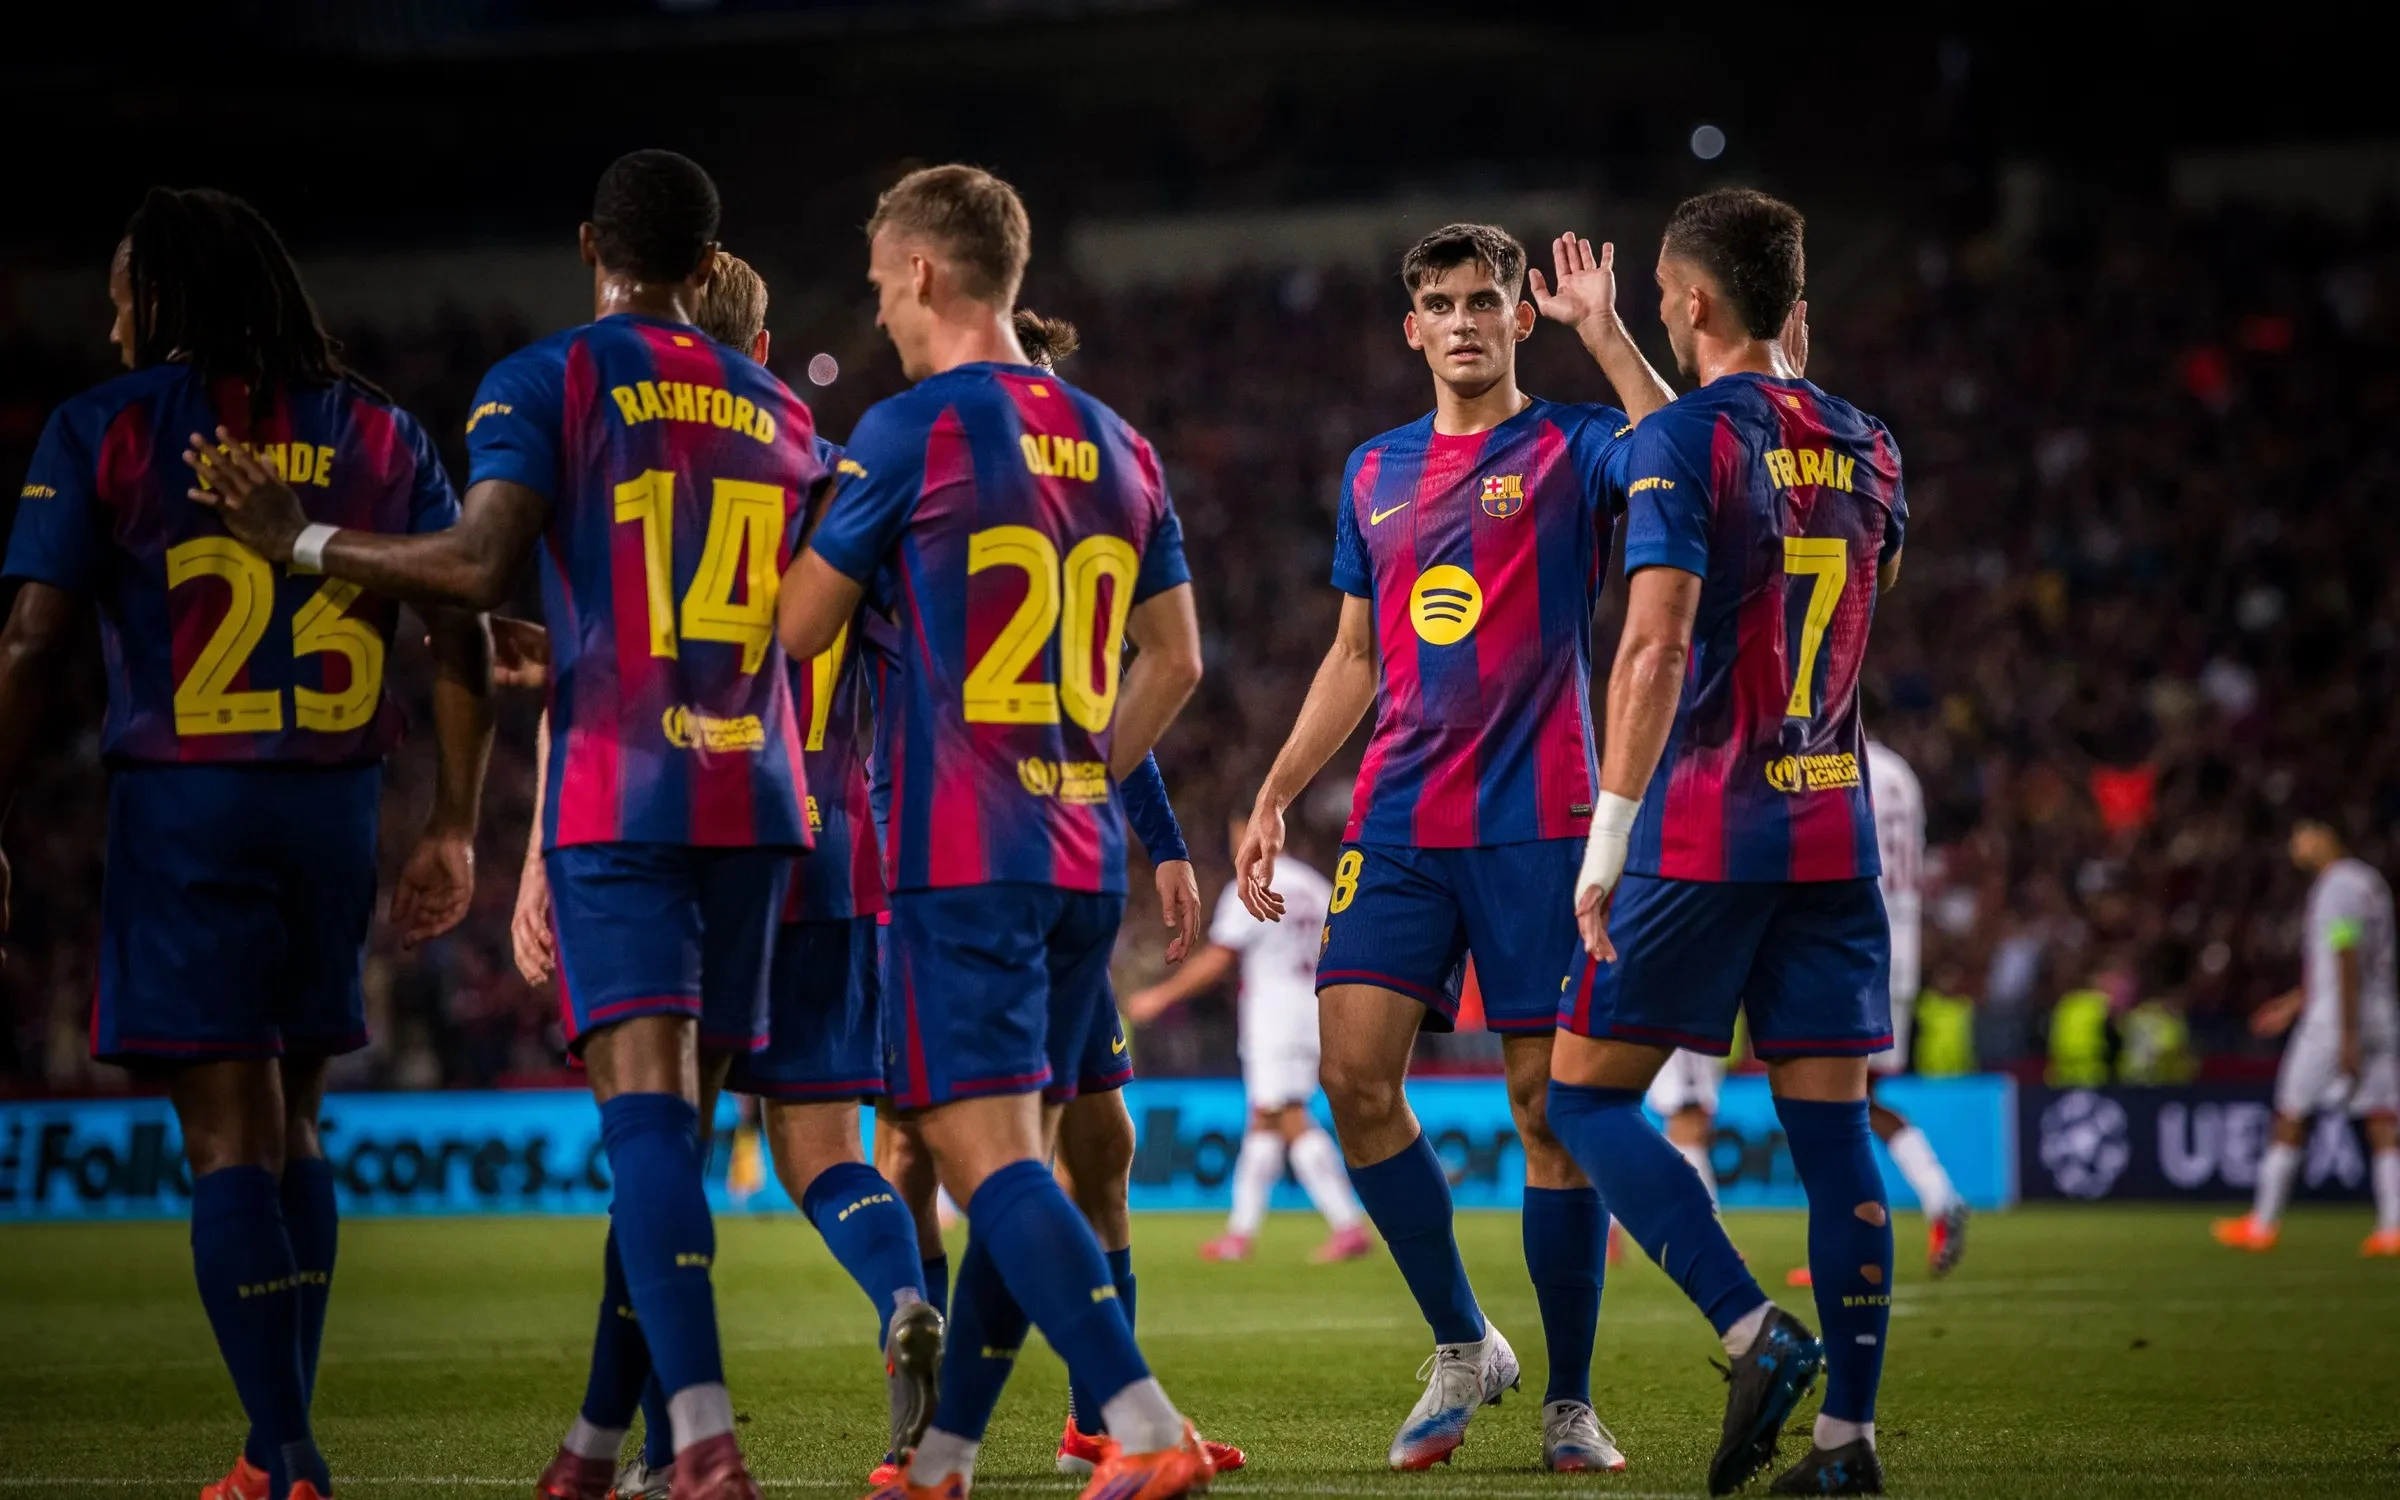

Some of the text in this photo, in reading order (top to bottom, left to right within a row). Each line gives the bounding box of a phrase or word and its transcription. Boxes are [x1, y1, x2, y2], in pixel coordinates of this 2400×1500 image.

[613, 381, 776, 444] RASHFORD
[1021, 434, 1100, 482] OLMO
[1764, 448, 1856, 494] FERRAN
[614, 469, 785, 675] 14
[166, 536, 385, 737] 23
[963, 525, 1140, 734] 20
[1784, 536, 1848, 718] 7
[1807, 765, 1860, 786] ACNUR
[1330, 850, 1365, 914] 8
[2156, 1101, 2367, 1190] UEA
